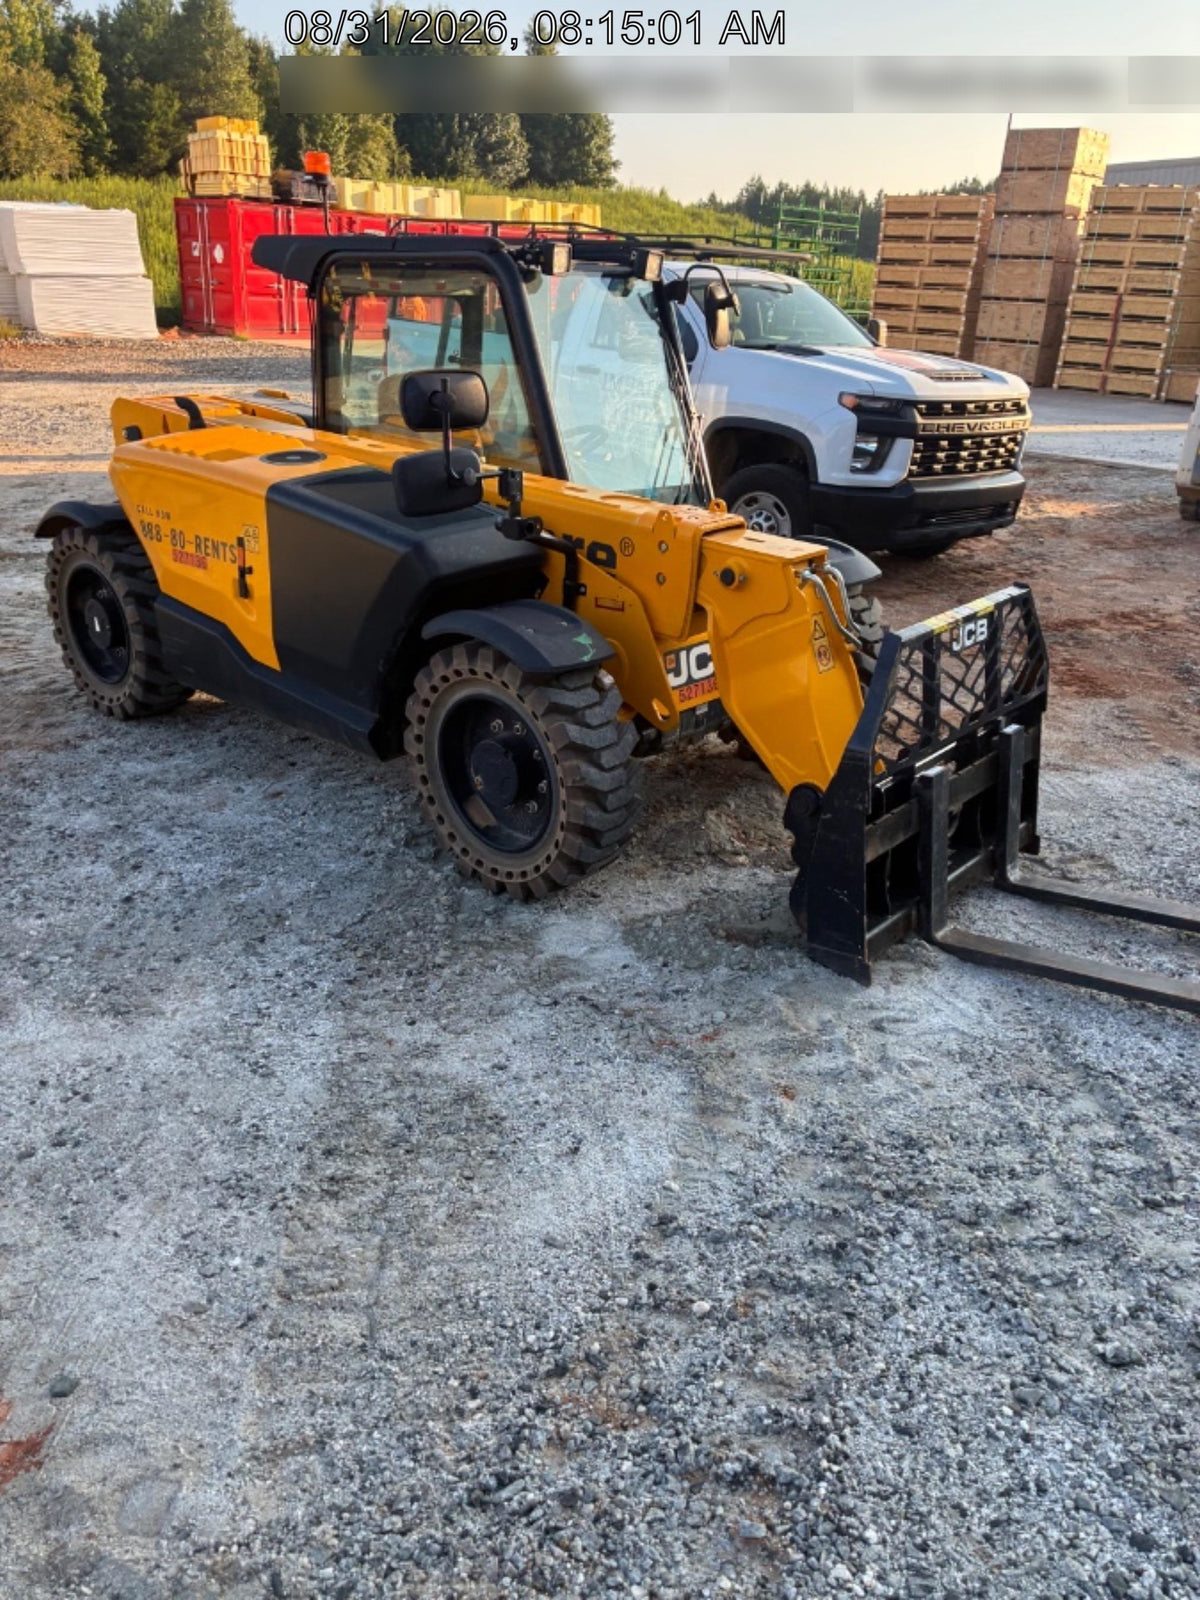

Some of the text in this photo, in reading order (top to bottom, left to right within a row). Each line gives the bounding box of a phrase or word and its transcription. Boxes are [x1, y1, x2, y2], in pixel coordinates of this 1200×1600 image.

[921, 419, 1029, 432] CHEVROLET
[953, 619, 987, 651] JCB
[665, 643, 715, 687] JC
